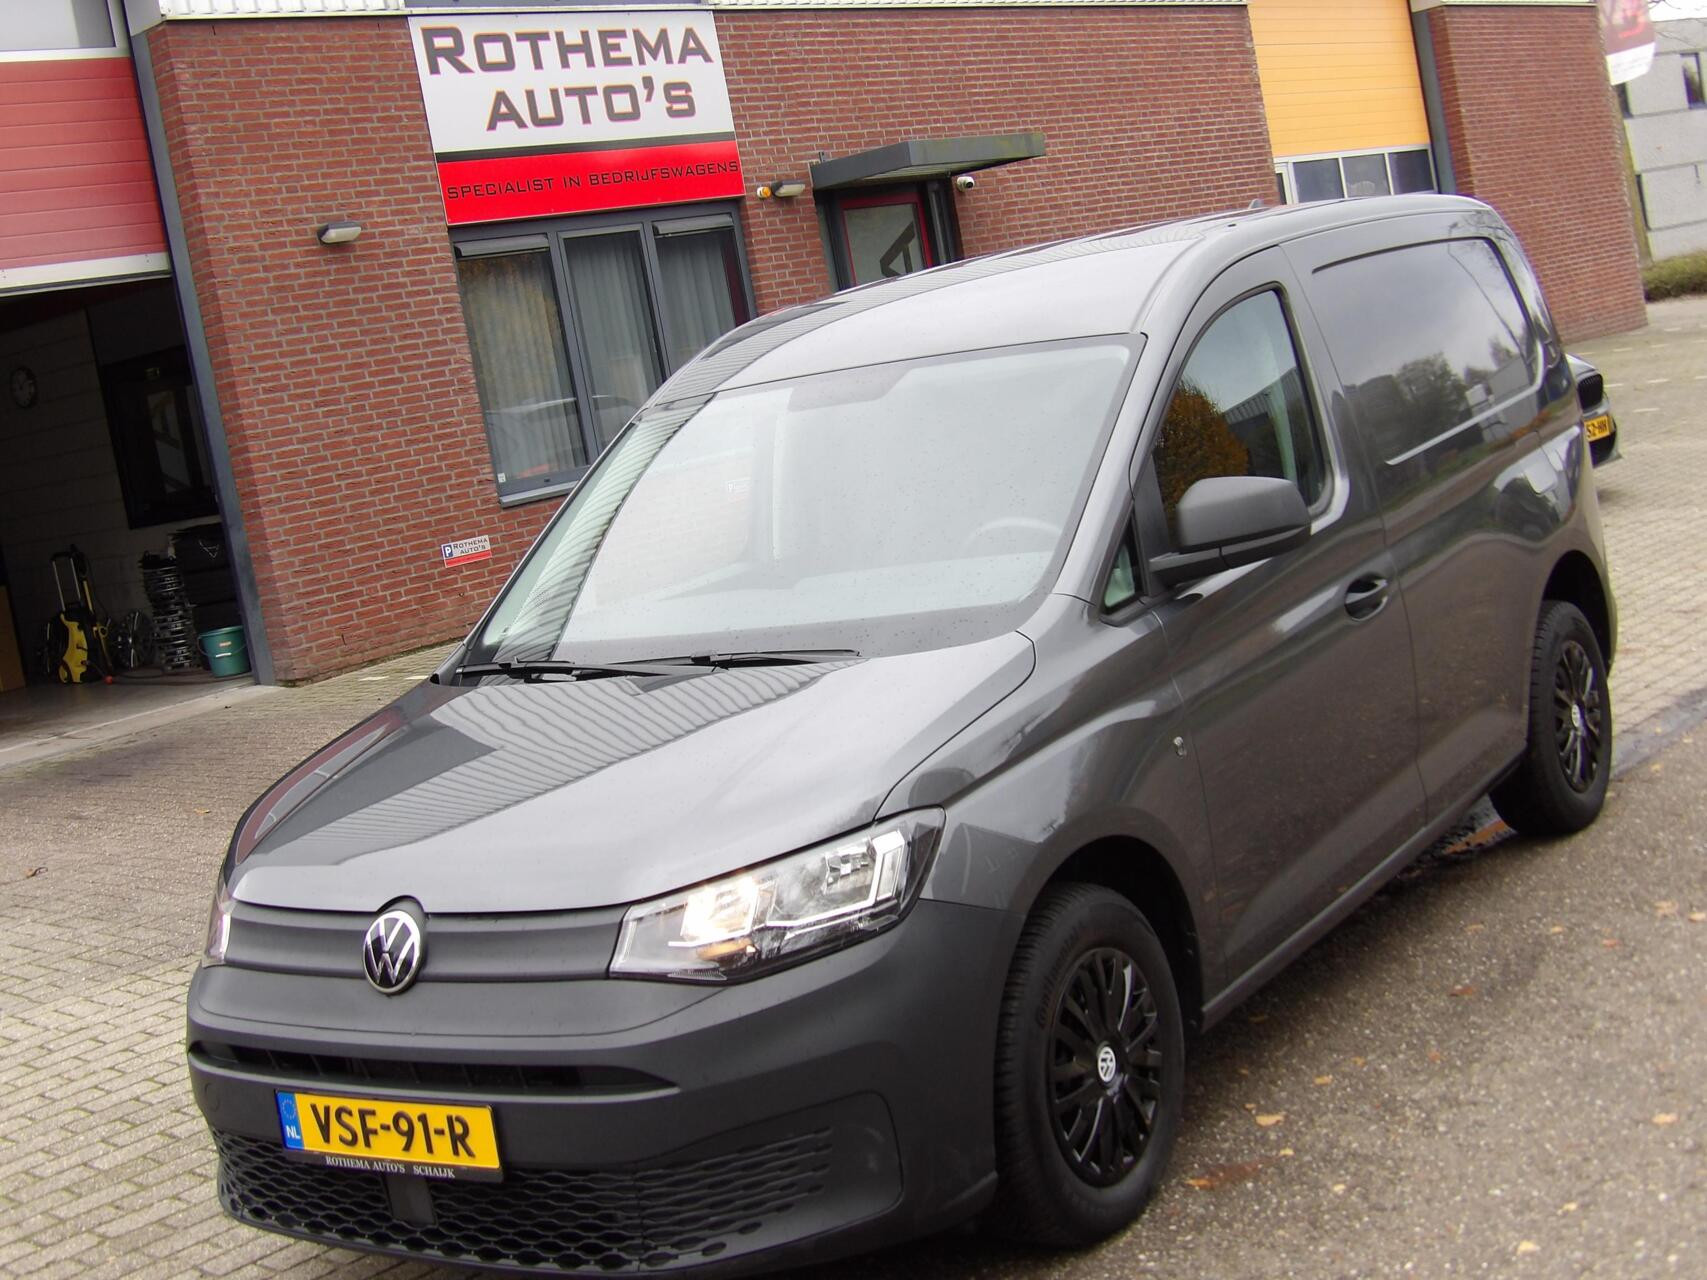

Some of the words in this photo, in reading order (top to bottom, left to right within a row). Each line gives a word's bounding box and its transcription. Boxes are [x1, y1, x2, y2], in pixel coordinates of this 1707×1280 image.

[420, 25, 714, 75] ROTHEMA
[486, 75, 697, 132] AUTO'S
[447, 177, 554, 199] SPECIALIST
[563, 176, 581, 189] IN
[589, 160, 739, 186] BEDRIJFSWAGENS
[445, 547, 452, 557] P
[453, 538, 488, 550] ROTHEMA
[460, 545, 486, 555] AUTO'S
[286, 1125, 300, 1140] NL
[310, 1103, 476, 1158] VSF-91-R
[325, 1156, 371, 1170] ROTHEMA
[372, 1161, 406, 1174] AUTO'S
